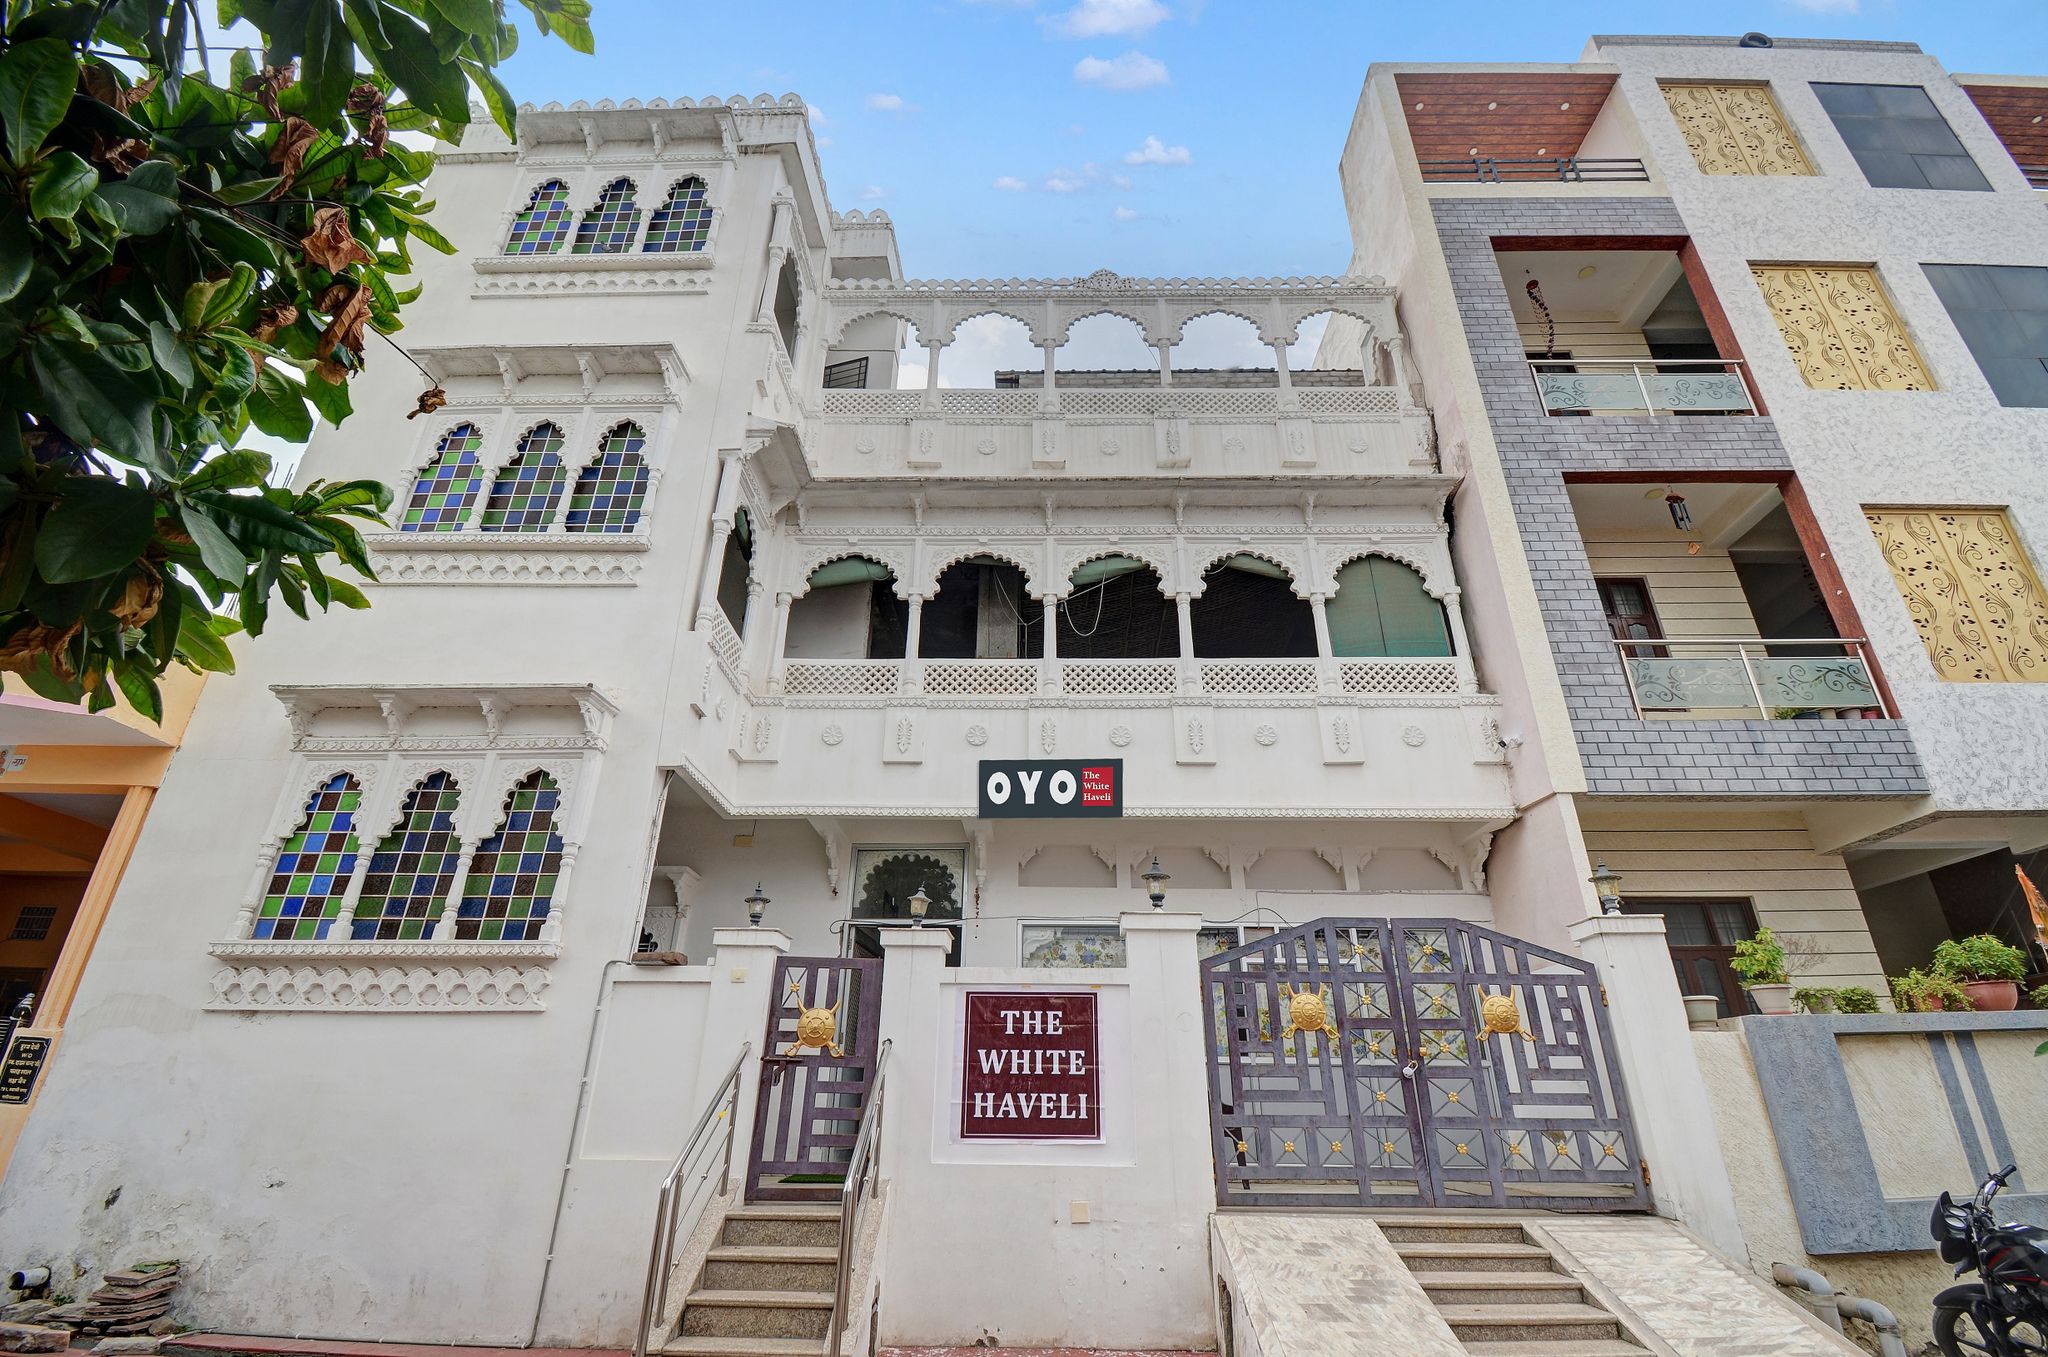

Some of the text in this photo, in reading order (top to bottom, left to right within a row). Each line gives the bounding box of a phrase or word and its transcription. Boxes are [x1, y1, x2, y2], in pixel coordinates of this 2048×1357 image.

[987, 769, 1077, 805] OYO
[1083, 771, 1100, 779] The
[1083, 782, 1110, 790] White
[1083, 793, 1111, 801] Haveli
[1000, 1010, 1063, 1035] THE
[977, 1049, 1086, 1075] WHITE
[973, 1092, 1088, 1119] HAVELI
